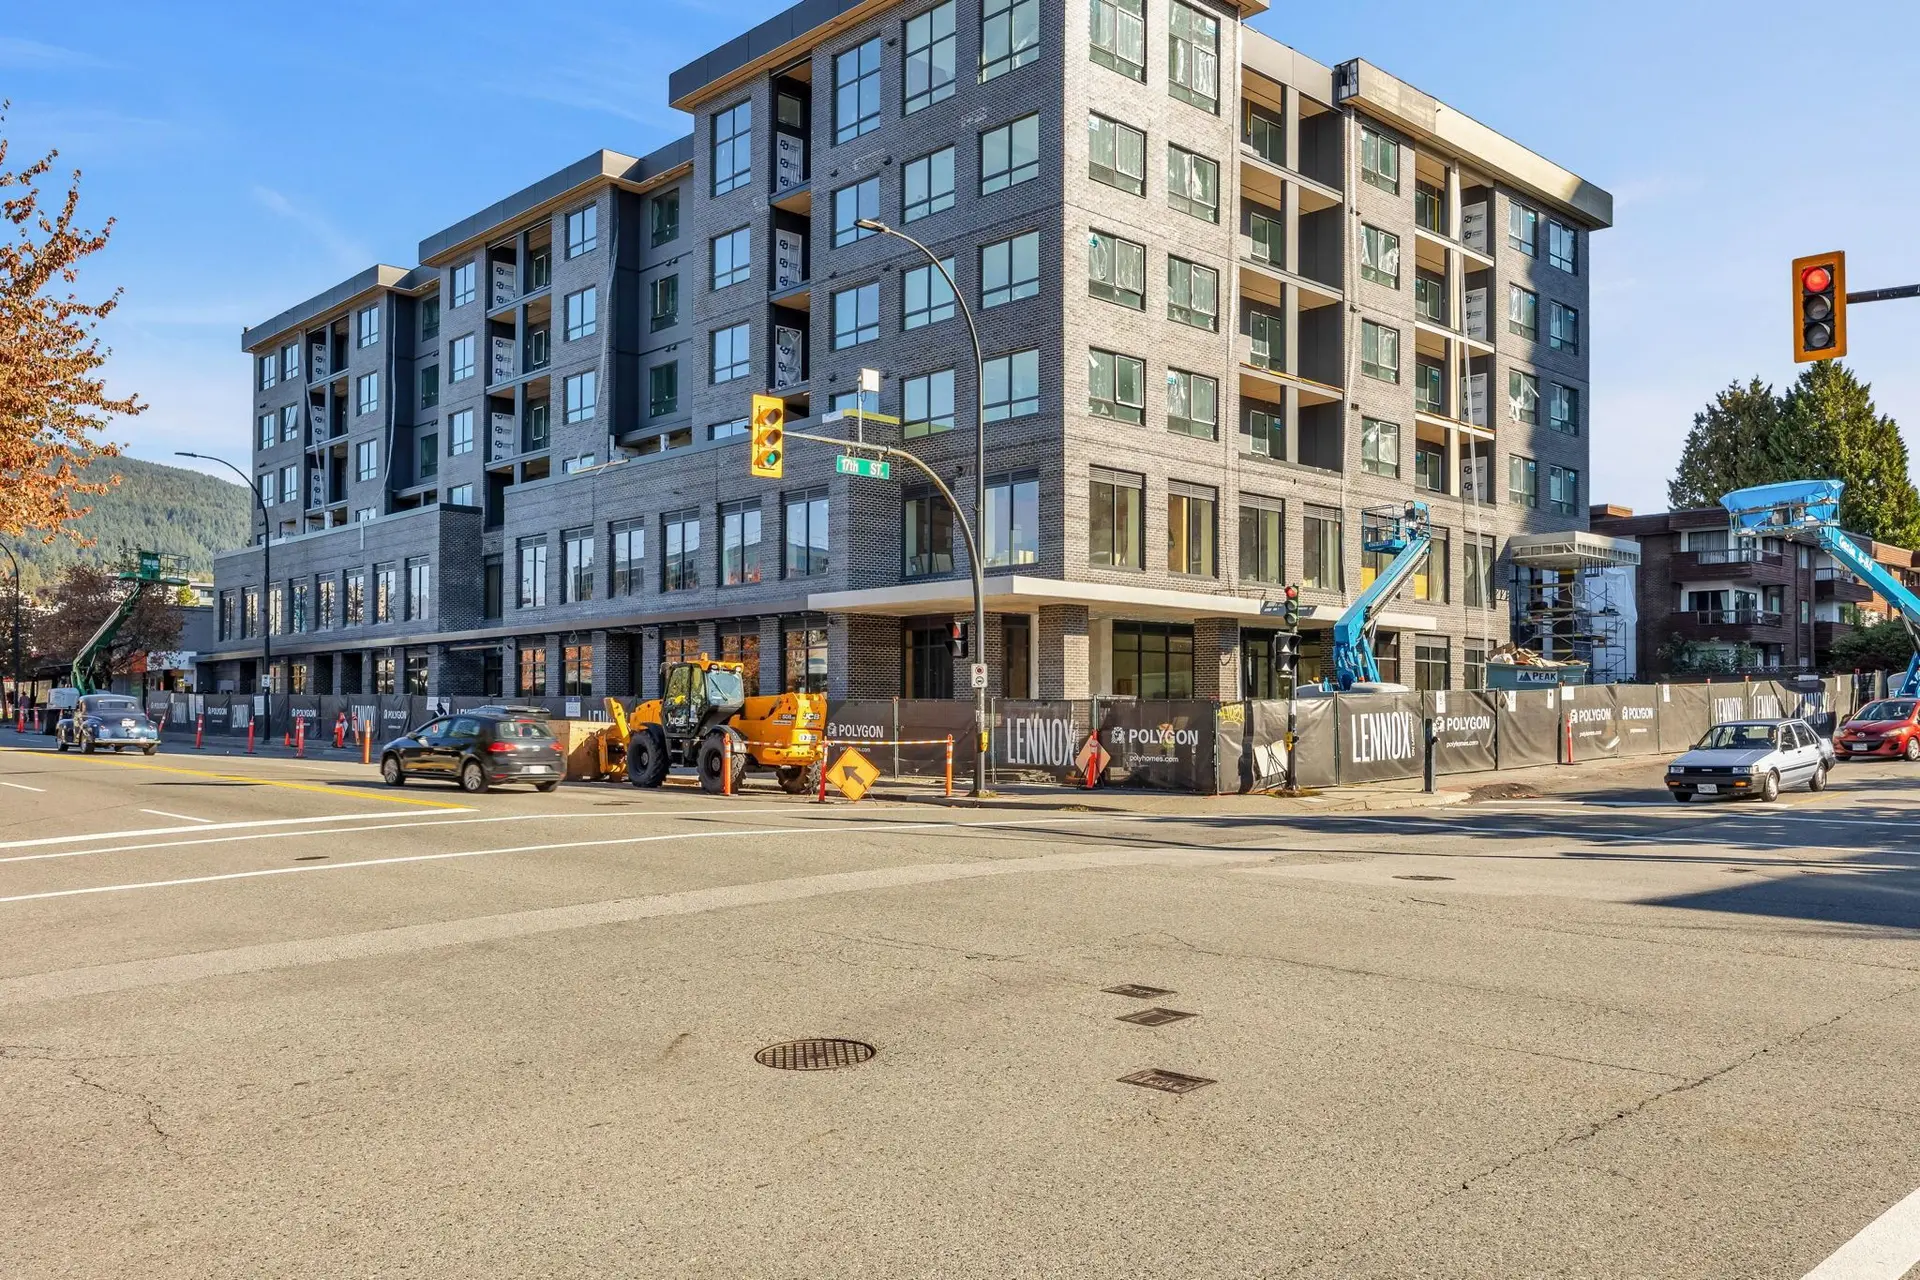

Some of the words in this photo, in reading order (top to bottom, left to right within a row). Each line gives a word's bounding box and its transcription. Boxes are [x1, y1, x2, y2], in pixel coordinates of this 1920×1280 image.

[841, 459, 859, 473] 17th
[1533, 671, 1557, 681] PEAK
[1578, 708, 1612, 722] POLYGON
[1628, 708, 1653, 719] POLYGON
[671, 717, 684, 725] JCB
[1447, 716, 1490, 731] POLYGON
[839, 724, 884, 738] POLYGON
[1129, 728, 1199, 746] POLYGON
[1351, 711, 1412, 763] LENNOX
[1007, 717, 1075, 766] LENNOX
[1129, 753, 1179, 763] polyhomes.com
